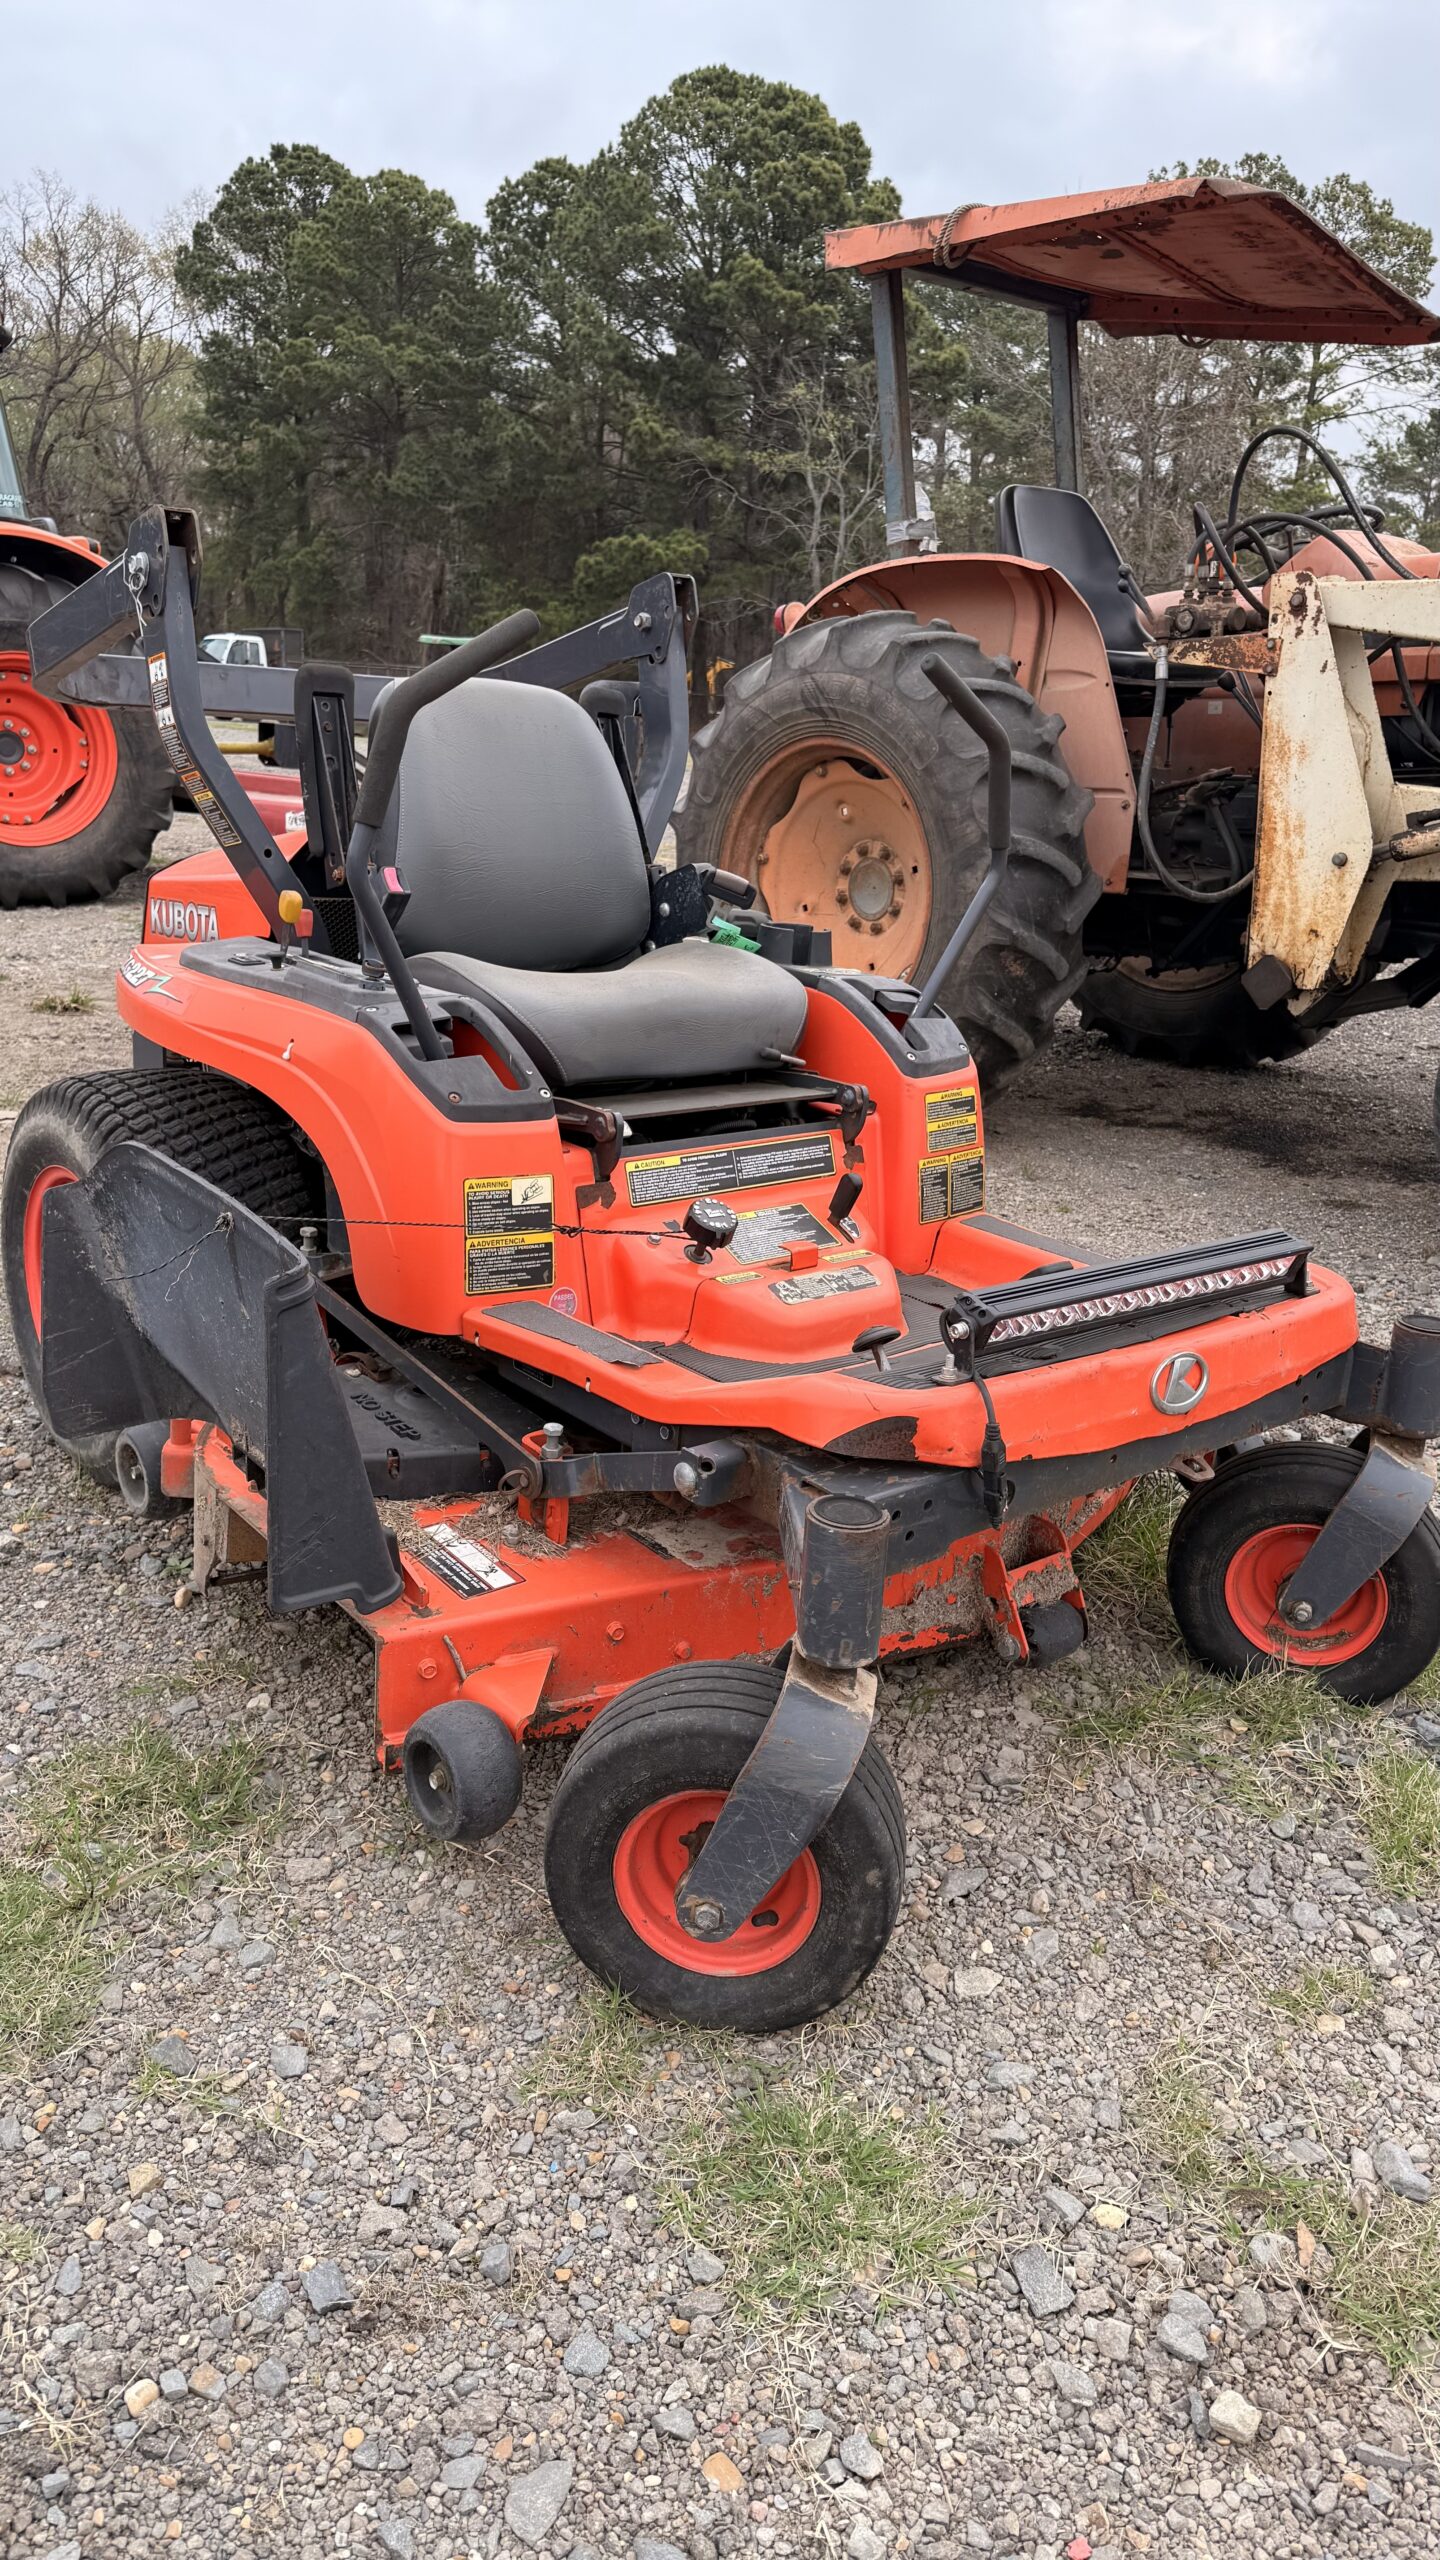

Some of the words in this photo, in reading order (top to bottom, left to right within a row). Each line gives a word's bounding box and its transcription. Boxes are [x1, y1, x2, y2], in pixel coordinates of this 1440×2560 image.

[150, 897, 219, 942] KUBOTA
[640, 1159, 665, 1169] CAUTION
[475, 1181, 509, 1189] WARNING
[476, 1237, 526, 1247] ADVERTENCIA
[350, 1393, 381, 1411] NO
[374, 1410, 421, 1440] STEP
